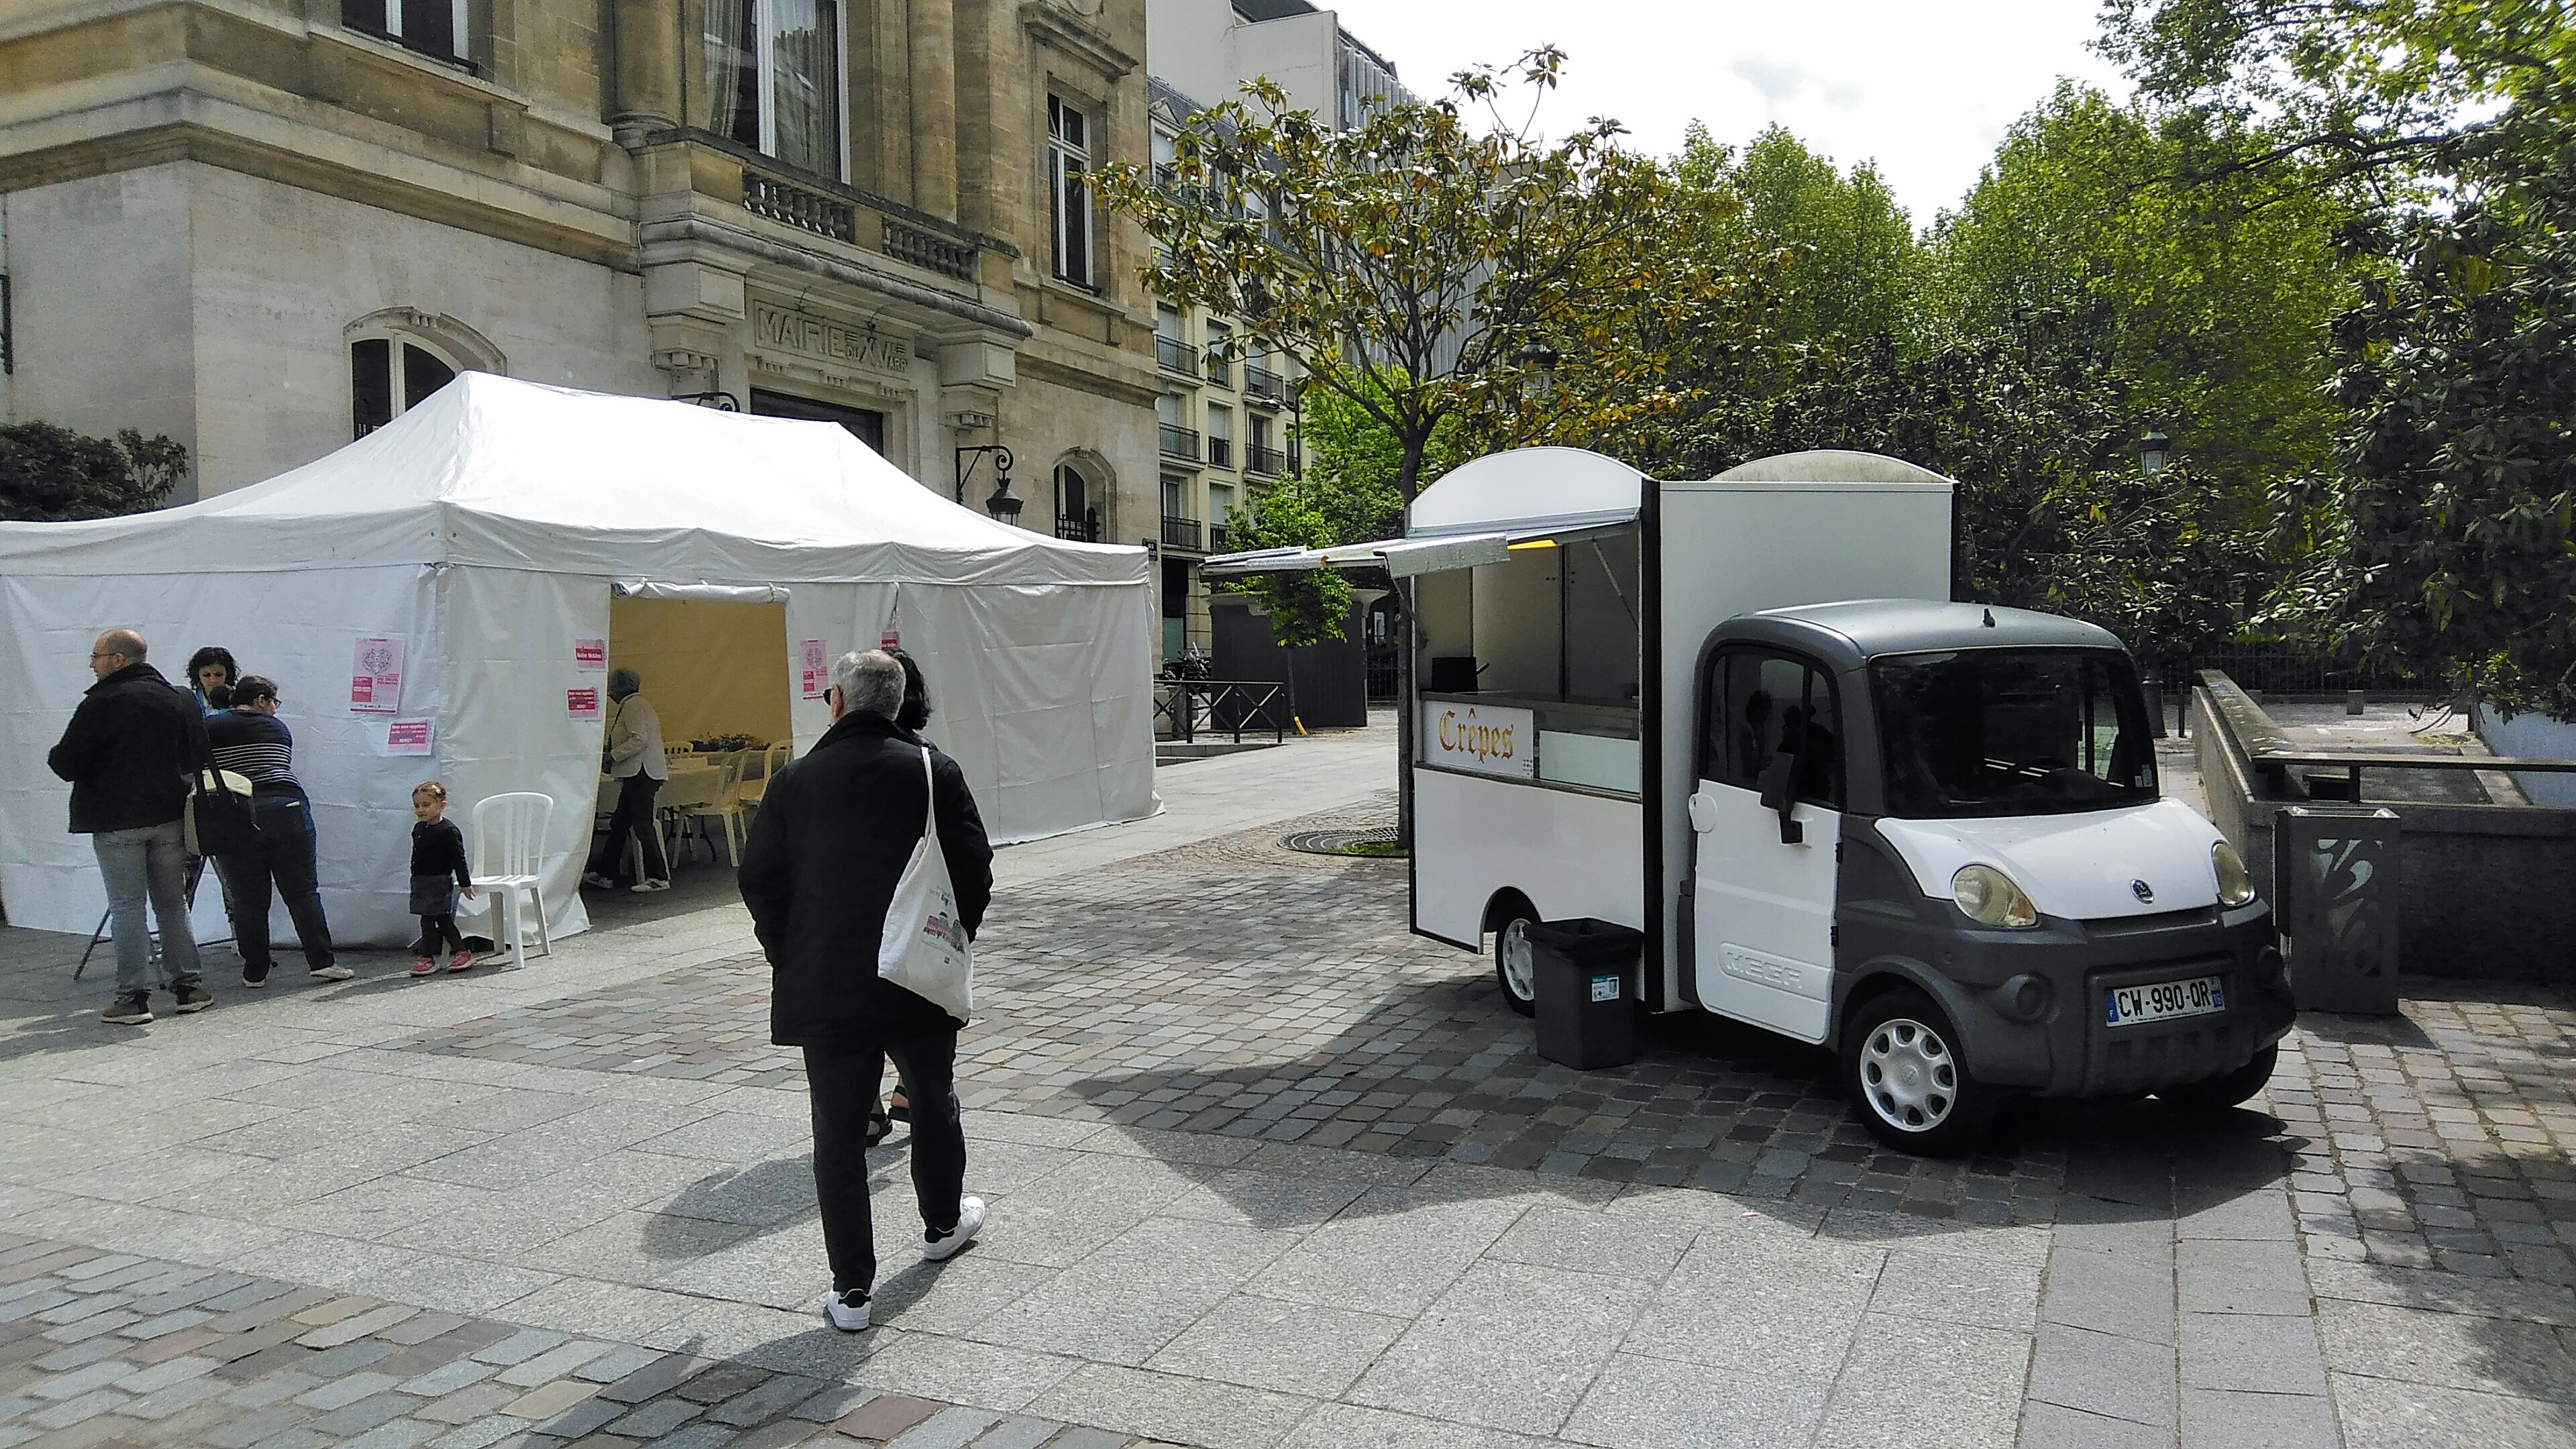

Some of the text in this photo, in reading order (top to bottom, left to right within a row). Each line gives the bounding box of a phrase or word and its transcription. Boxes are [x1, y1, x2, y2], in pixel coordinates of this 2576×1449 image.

[758, 309, 845, 358] MAIRIE
[846, 345, 861, 361] DU
[1439, 708, 1514, 764] Crêpes
[2118, 981, 2211, 1017] CW-990-QR
